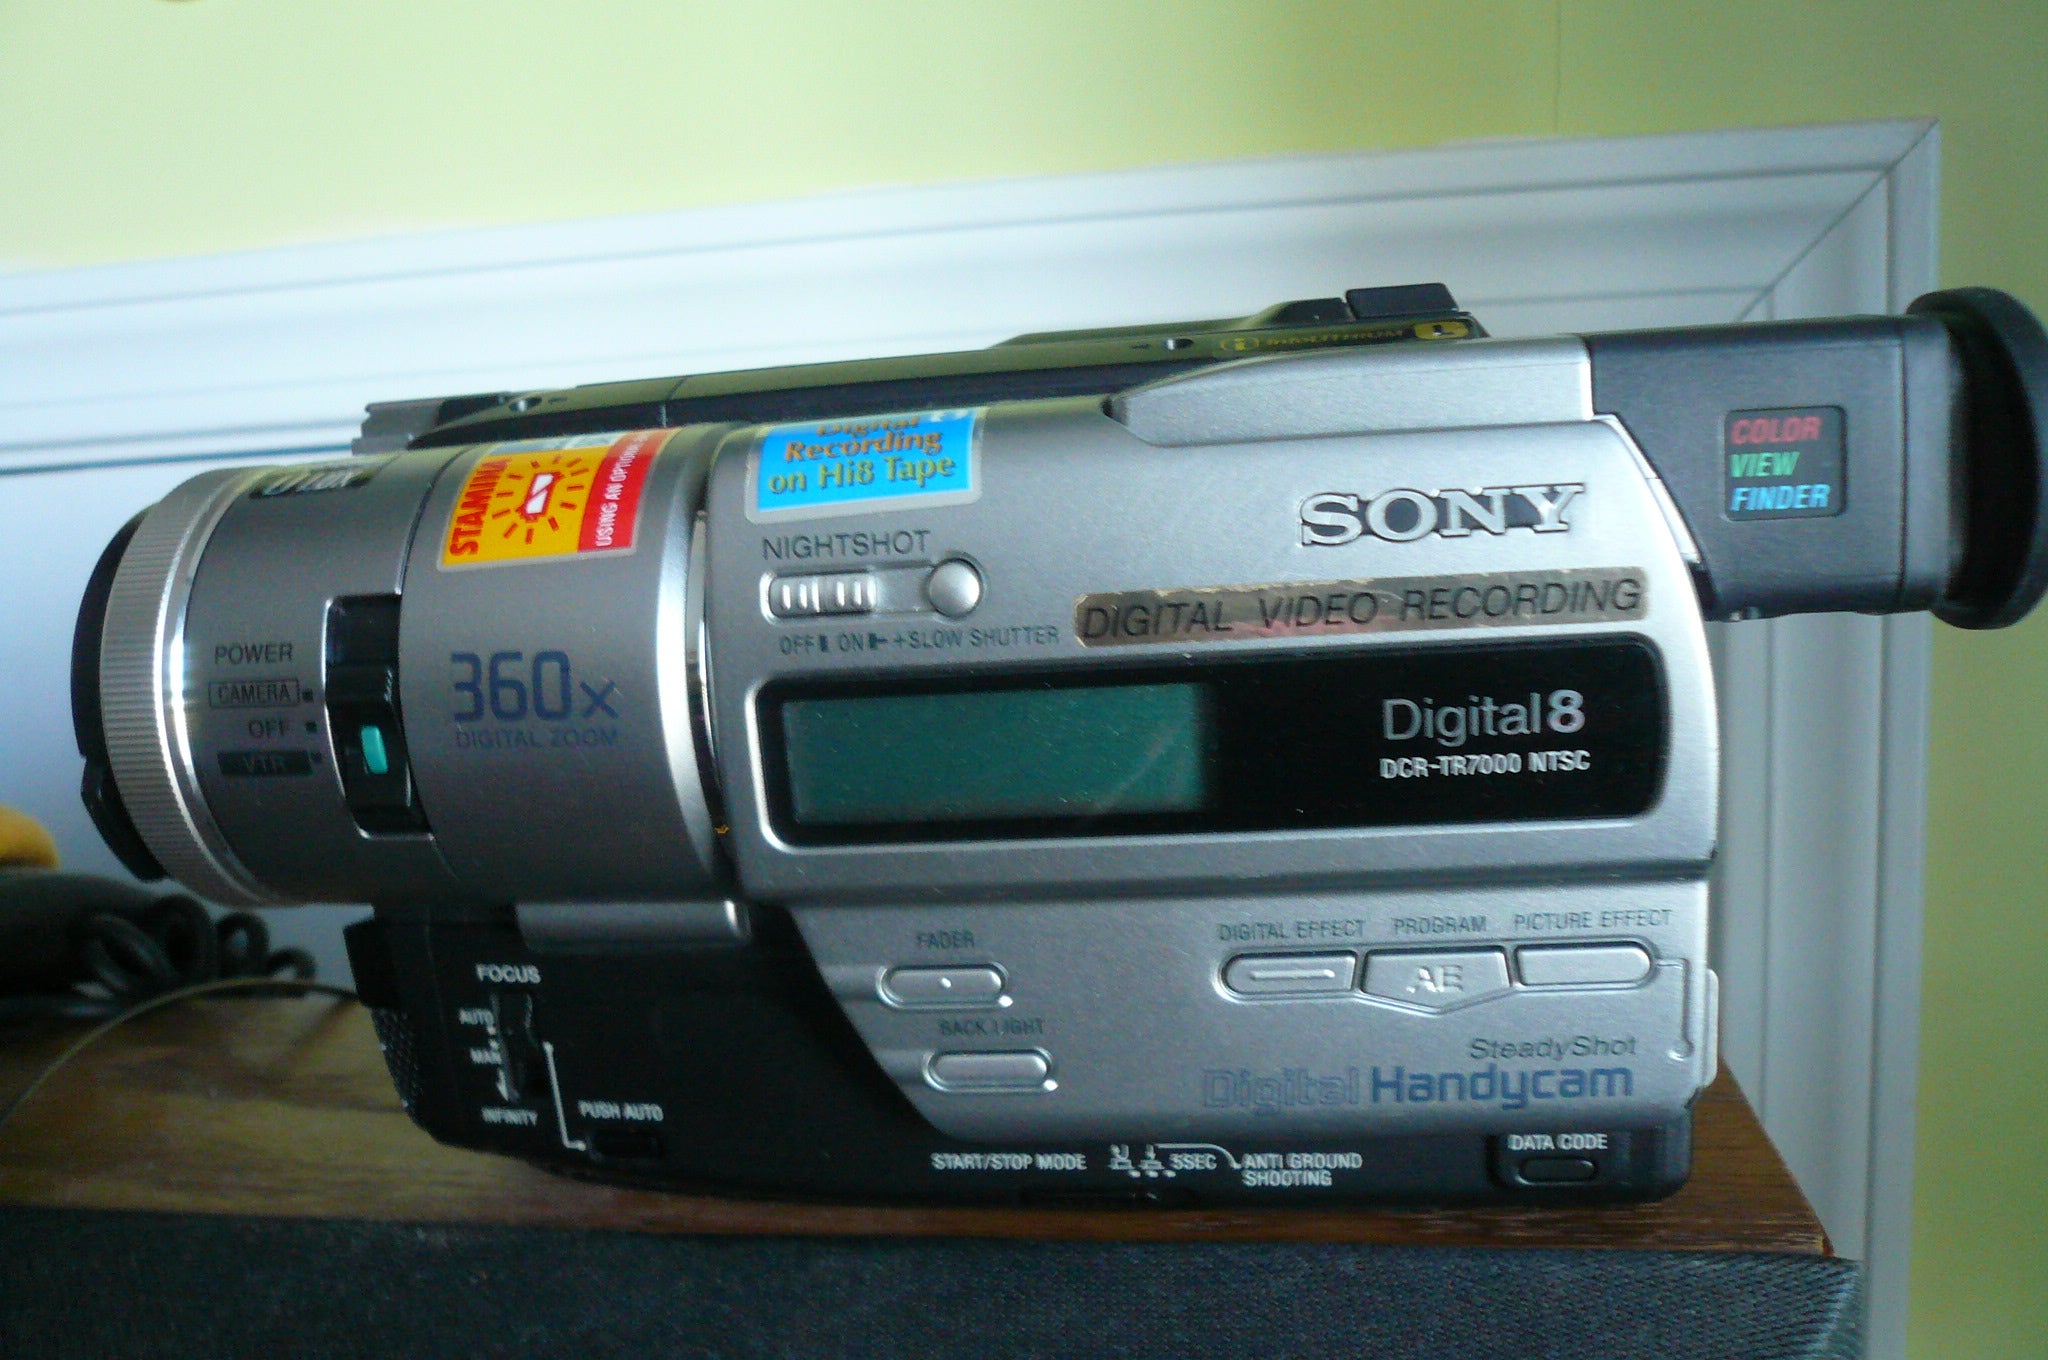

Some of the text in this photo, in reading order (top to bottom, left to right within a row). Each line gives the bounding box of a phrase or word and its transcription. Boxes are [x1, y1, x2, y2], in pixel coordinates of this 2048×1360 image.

[1731, 415, 1822, 444] COLOR
[785, 431, 943, 462] Recording
[769, 456, 955, 494] on Hi8 Tape
[1729, 451, 1800, 477] VIEW
[605, 477, 624, 501] AN
[1730, 483, 1831, 512] FINDER
[596, 503, 619, 547] USING
[1300, 483, 1585, 547] SONY
[762, 531, 930, 560] NIGHTSHOT
[1083, 578, 1642, 639] DIGITAL VIDEO RECORDING
[779, 635, 815, 655] OFF
[839, 631, 865, 652] ON
[969, 625, 1060, 647] SHUTTER
[214, 643, 294, 665] POWER
[217, 683, 291, 704] CAMERA
[450, 651, 619, 721] 360x
[248, 719, 290, 739] OFF
[455, 727, 619, 749] DIGITAL ZOOM
[1379, 750, 1591, 779] DCR-TR7000 NTSC
[1219, 919, 1365, 941] DIGITAL EFFECT
[1392, 914, 1487, 935] PROGRAM
[1513, 909, 1673, 931] PICTURE EFFECT
[917, 929, 976, 950] FADER
[476, 963, 542, 985] FOCUS
[1407, 965, 1464, 995] AE
[938, 1019, 986, 1037] BACK
[1469, 1035, 1637, 1061] SteadyShot
[1201, 1062, 1634, 1115] Digital Handycam
[578, 1101, 664, 1122] PUSH AUTO
[1507, 1133, 1608, 1151] DATA CODE
[930, 1153, 1087, 1172] START/STOP MODE
[1242, 1152, 1363, 1170] ANTI GROUND
[1242, 1170, 1333, 1187] SHOOTING
